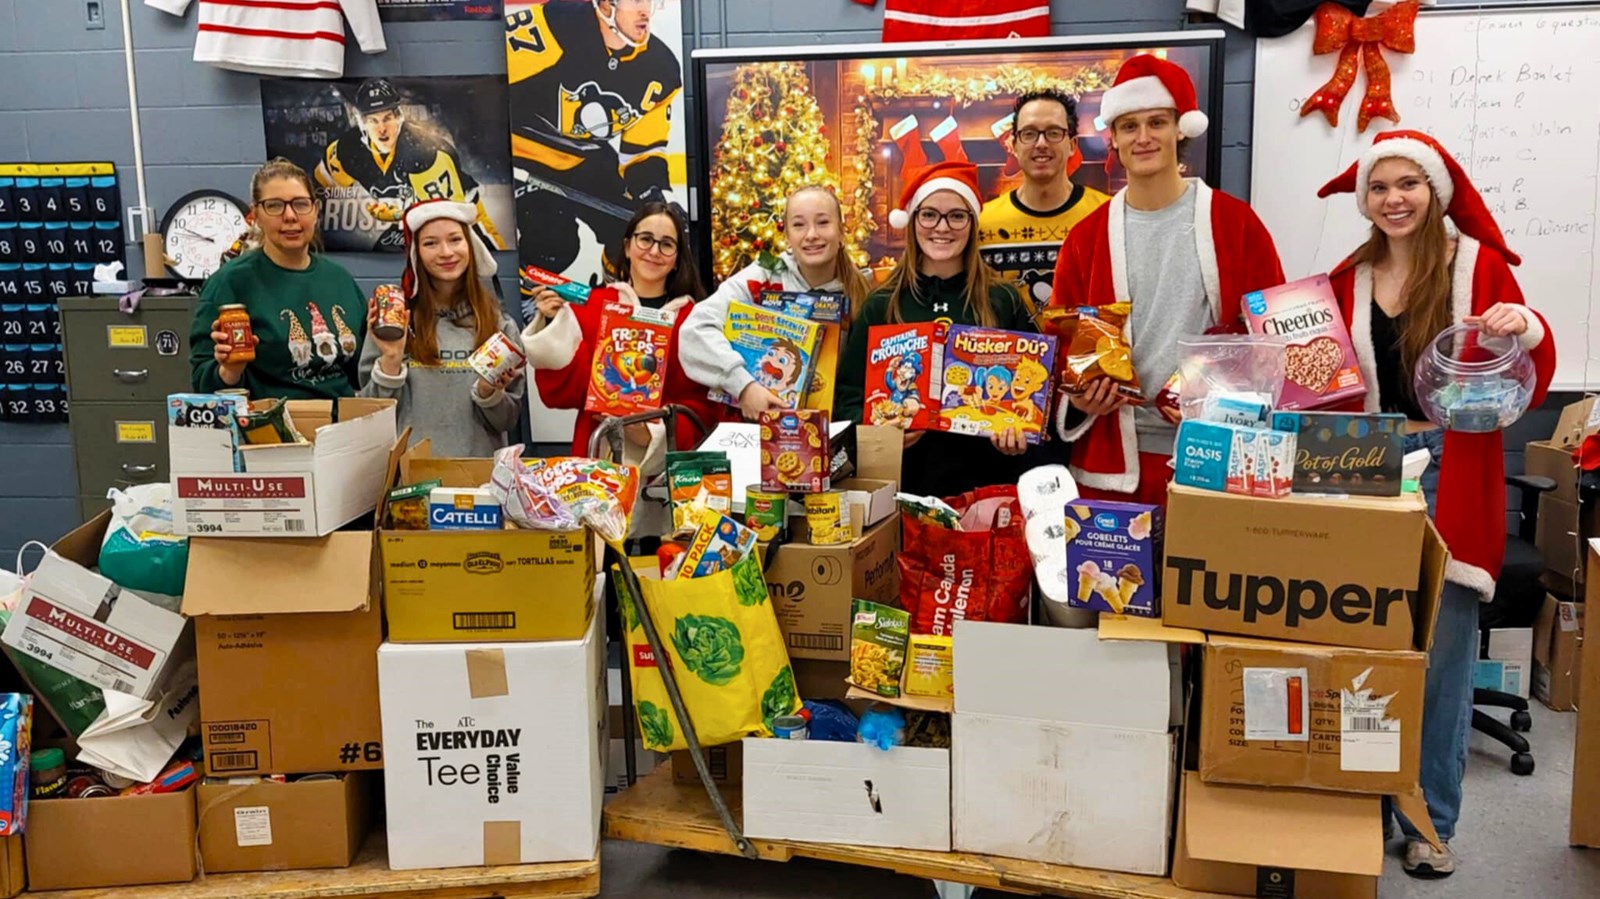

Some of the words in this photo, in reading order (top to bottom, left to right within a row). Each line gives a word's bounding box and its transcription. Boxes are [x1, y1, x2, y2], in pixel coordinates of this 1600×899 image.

[641, 81, 662, 110] C
[325, 186, 359, 199] SIDNEY
[20, 198, 31, 212] 3
[47, 197, 57, 211] 4
[70, 198, 81, 212] 5
[95, 198, 106, 212] 6
[187, 204, 197, 215] 11
[202, 198, 215, 210] 12
[224, 203, 228, 214] 1
[174, 218, 186, 229] 10
[233, 215, 241, 226] 2
[0, 240, 11, 254] 8
[25, 240, 36, 254] 9
[47, 240, 64, 253] 10
[74, 240, 88, 253] 11
[98, 240, 115, 253] 12
[170, 235, 179, 247] 9
[188, 266, 195, 276] 7
[528, 267, 565, 284] Colgate
[0, 281, 17, 294] 14
[24, 281, 42, 294] 15
[49, 281, 67, 294] 16
[74, 281, 89, 294] 17
[3, 321, 22, 334] 20
[29, 321, 46, 334] 21
[1262, 307, 1334, 336] Cheerios
[612, 328, 655, 343] FROOT
[880, 328, 918, 348] CAPTAINE
[615, 340, 654, 355] LOOPS
[871, 335, 929, 365] CROUNCHE
[5, 361, 25, 374] 26
[31, 361, 49, 374] 27
[9, 401, 29, 414] 32
[34, 400, 55, 413] 33
[190, 409, 215, 423] GO
[1224, 414, 1257, 428] IVORY
[1185, 445, 1223, 462] OASIS
[1321, 455, 1339, 472] of
[1340, 446, 1387, 470] Gold
[432, 508, 497, 524] CATELLI
[196, 524, 222, 532] 3994
[690, 523, 715, 562] PACK
[1075, 539, 1093, 547] POUR
[1087, 531, 1128, 543] GOBELETS
[517, 558, 554, 566] TORTILLAS
[1103, 560, 1113, 568] 18
[1167, 555, 1419, 629] Tupper
[26, 643, 53, 661] 3994
[415, 719, 434, 729] The
[457, 716, 476, 728] ATC
[416, 728, 521, 751] EVERYDAY
[1313, 734, 1341, 742] CARTO
[339, 741, 382, 764] #6
[417, 756, 481, 786] Tee
[506, 753, 521, 794] Value
[486, 754, 501, 804] Choice
